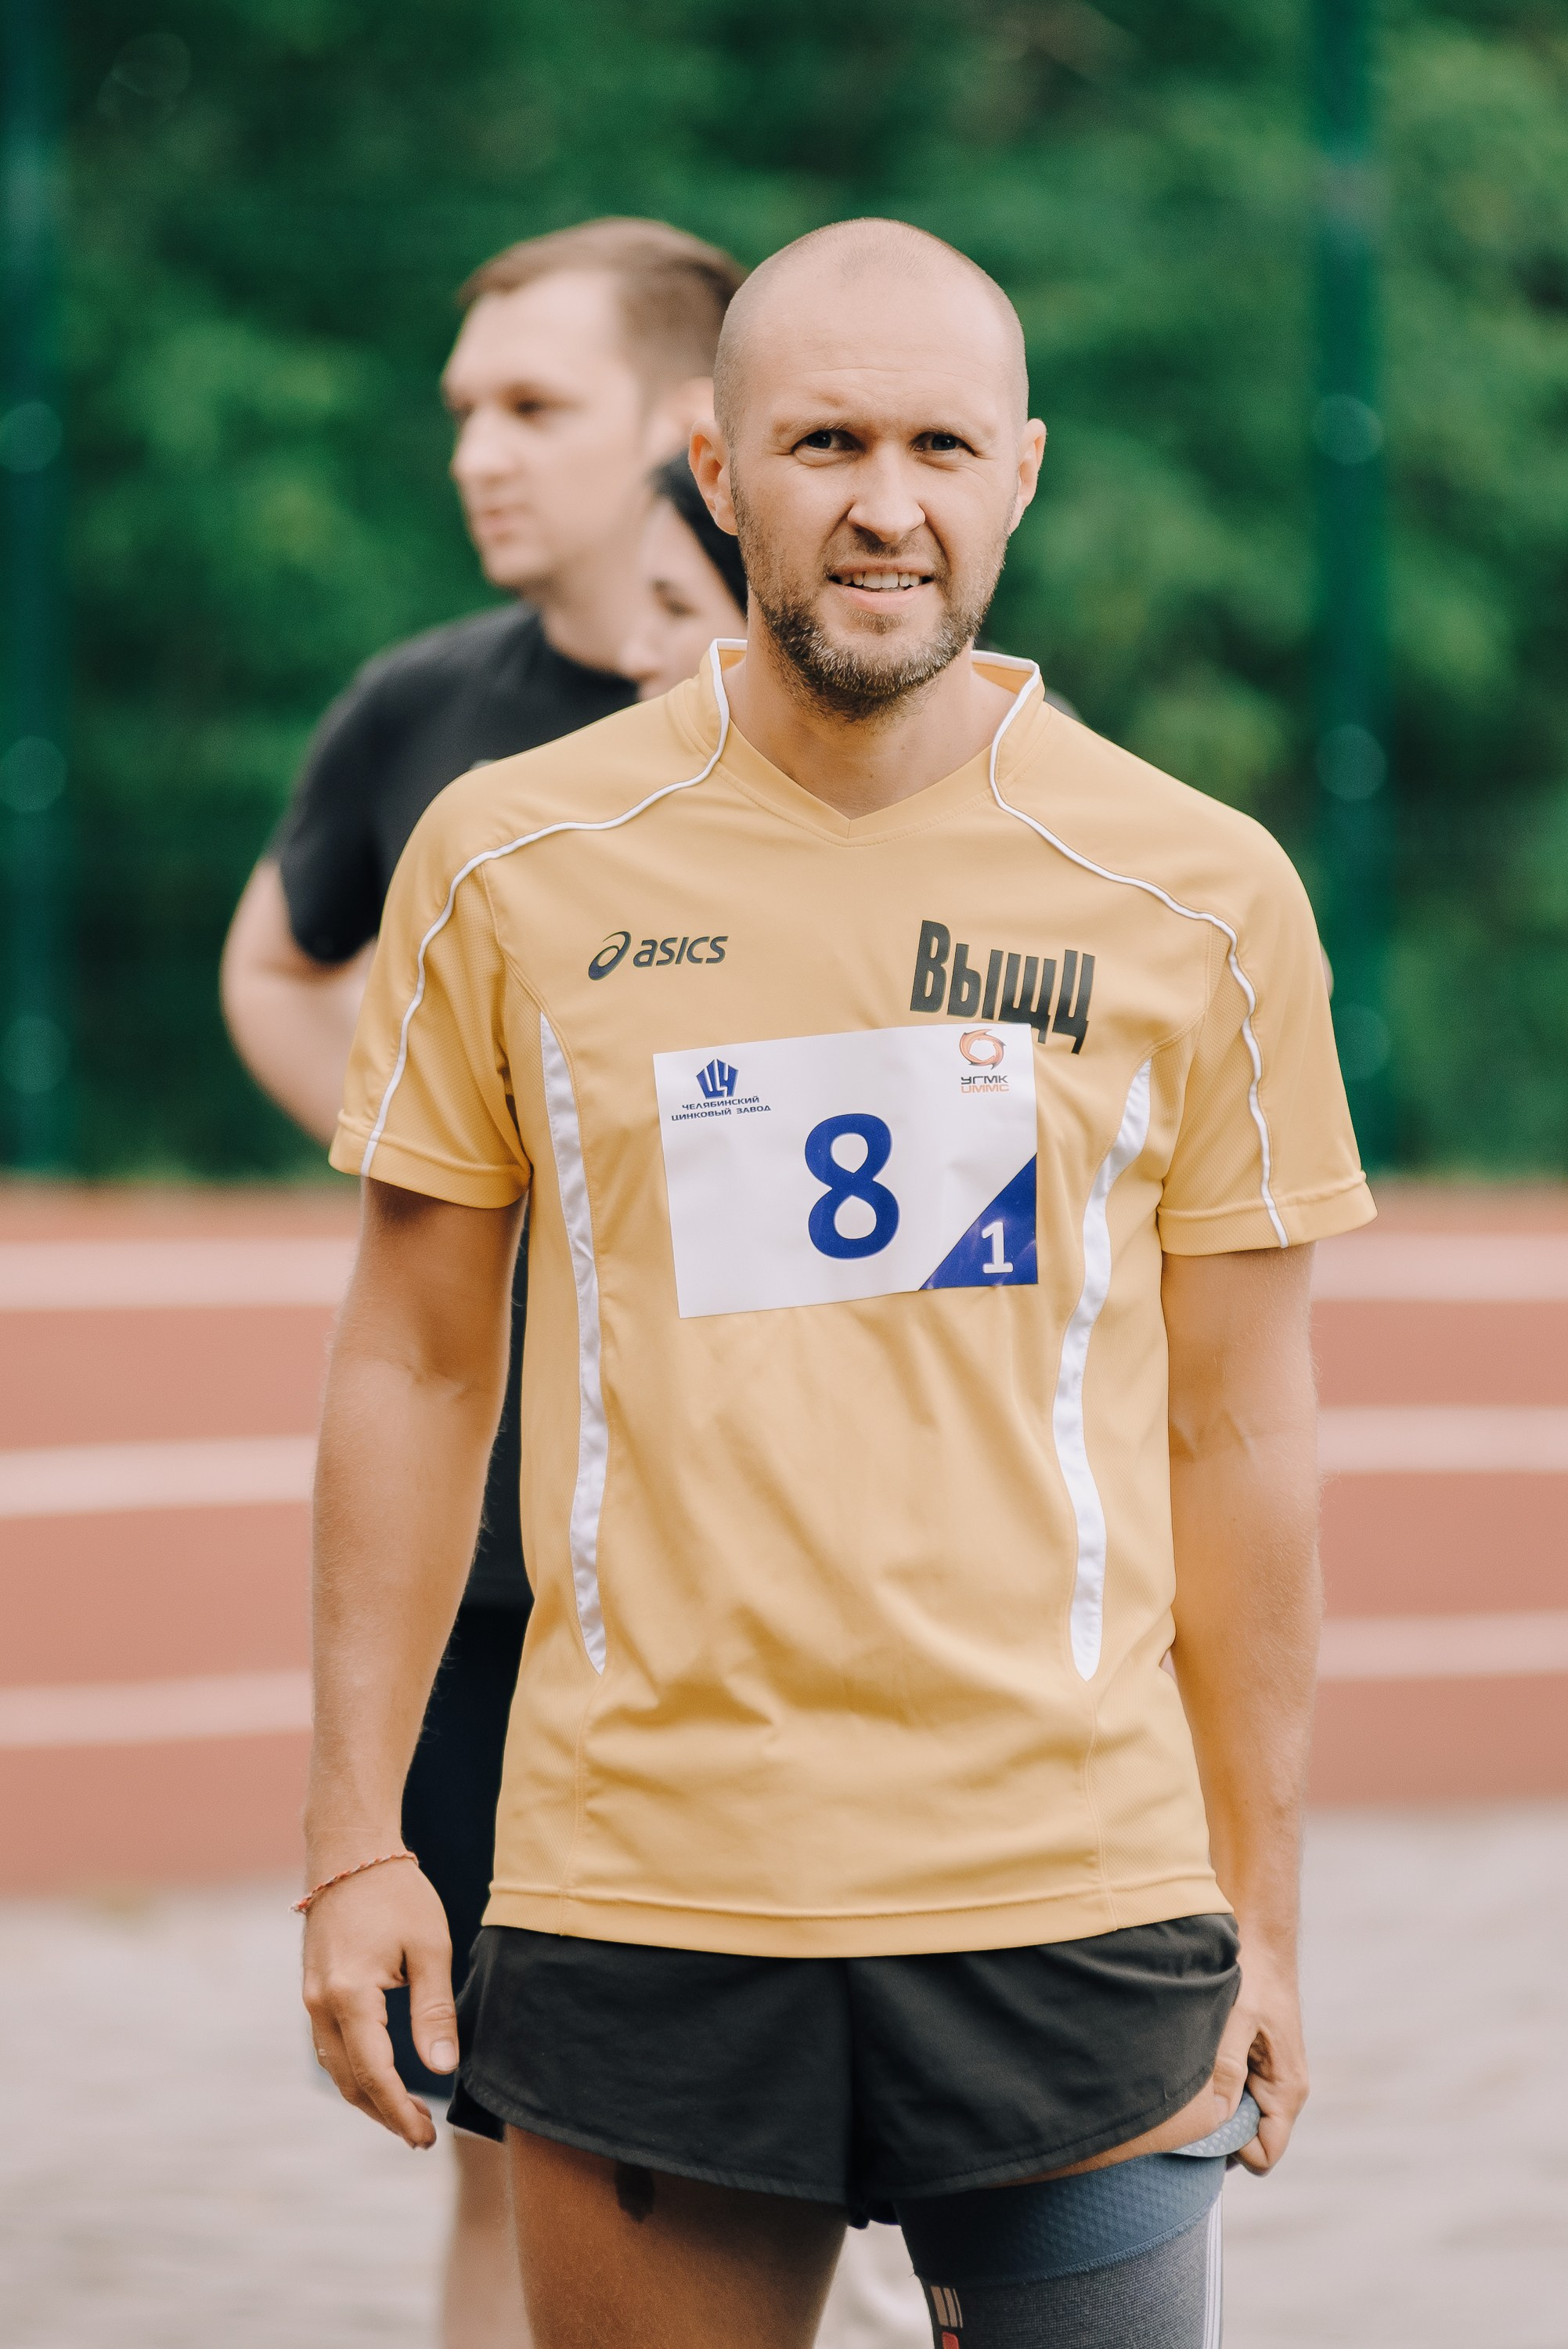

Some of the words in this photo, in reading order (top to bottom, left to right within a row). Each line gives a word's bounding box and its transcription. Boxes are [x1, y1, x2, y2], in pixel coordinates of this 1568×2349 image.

[961, 1075, 1008, 1084] УГМК
[961, 1084, 1010, 1094] UMMC
[682, 1095, 760, 1110] ЧЕЛЯБИНСКИЙ
[671, 1108, 732, 1121] ЦИНКОВЫЙ
[736, 1105, 772, 1115] ЗАВОД
[805, 1113, 899, 1260] 8
[982, 1221, 1014, 1274] 1
